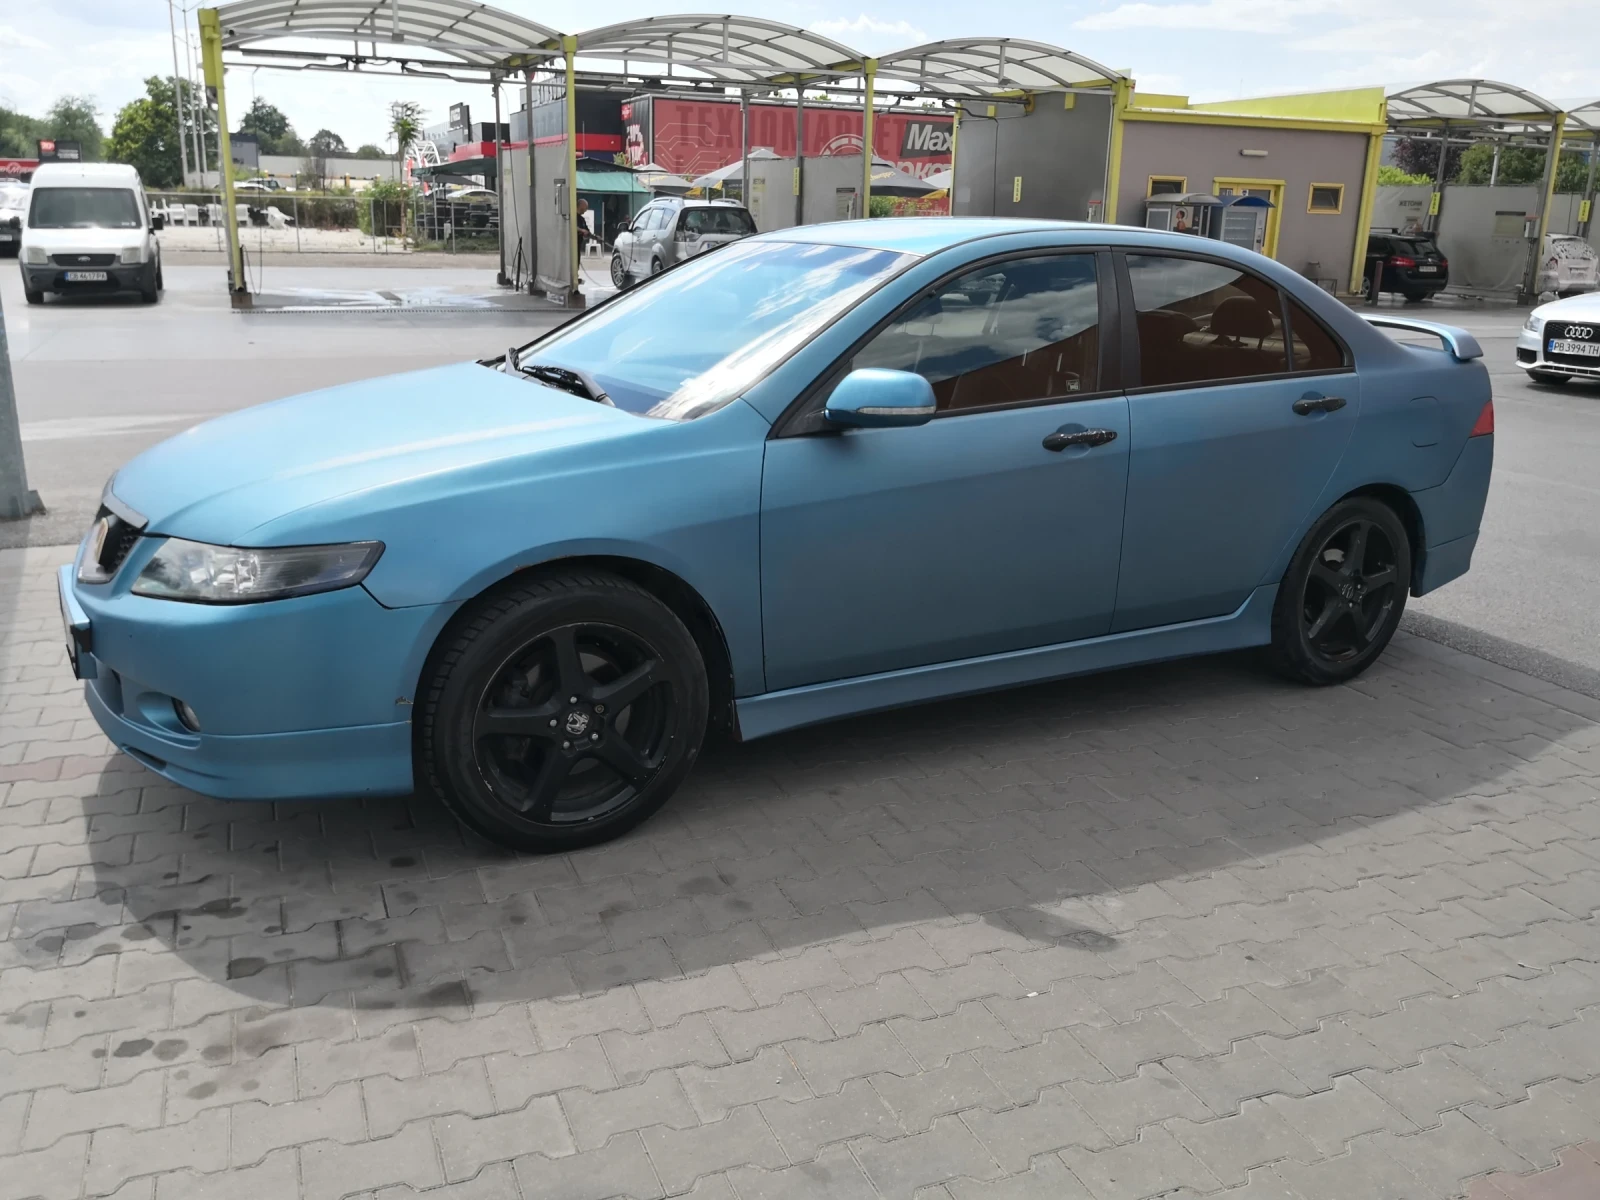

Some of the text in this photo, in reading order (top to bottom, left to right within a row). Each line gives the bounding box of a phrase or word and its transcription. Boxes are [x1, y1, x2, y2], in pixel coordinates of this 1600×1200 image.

[1554, 342, 1600, 355] PB 3994 TH
